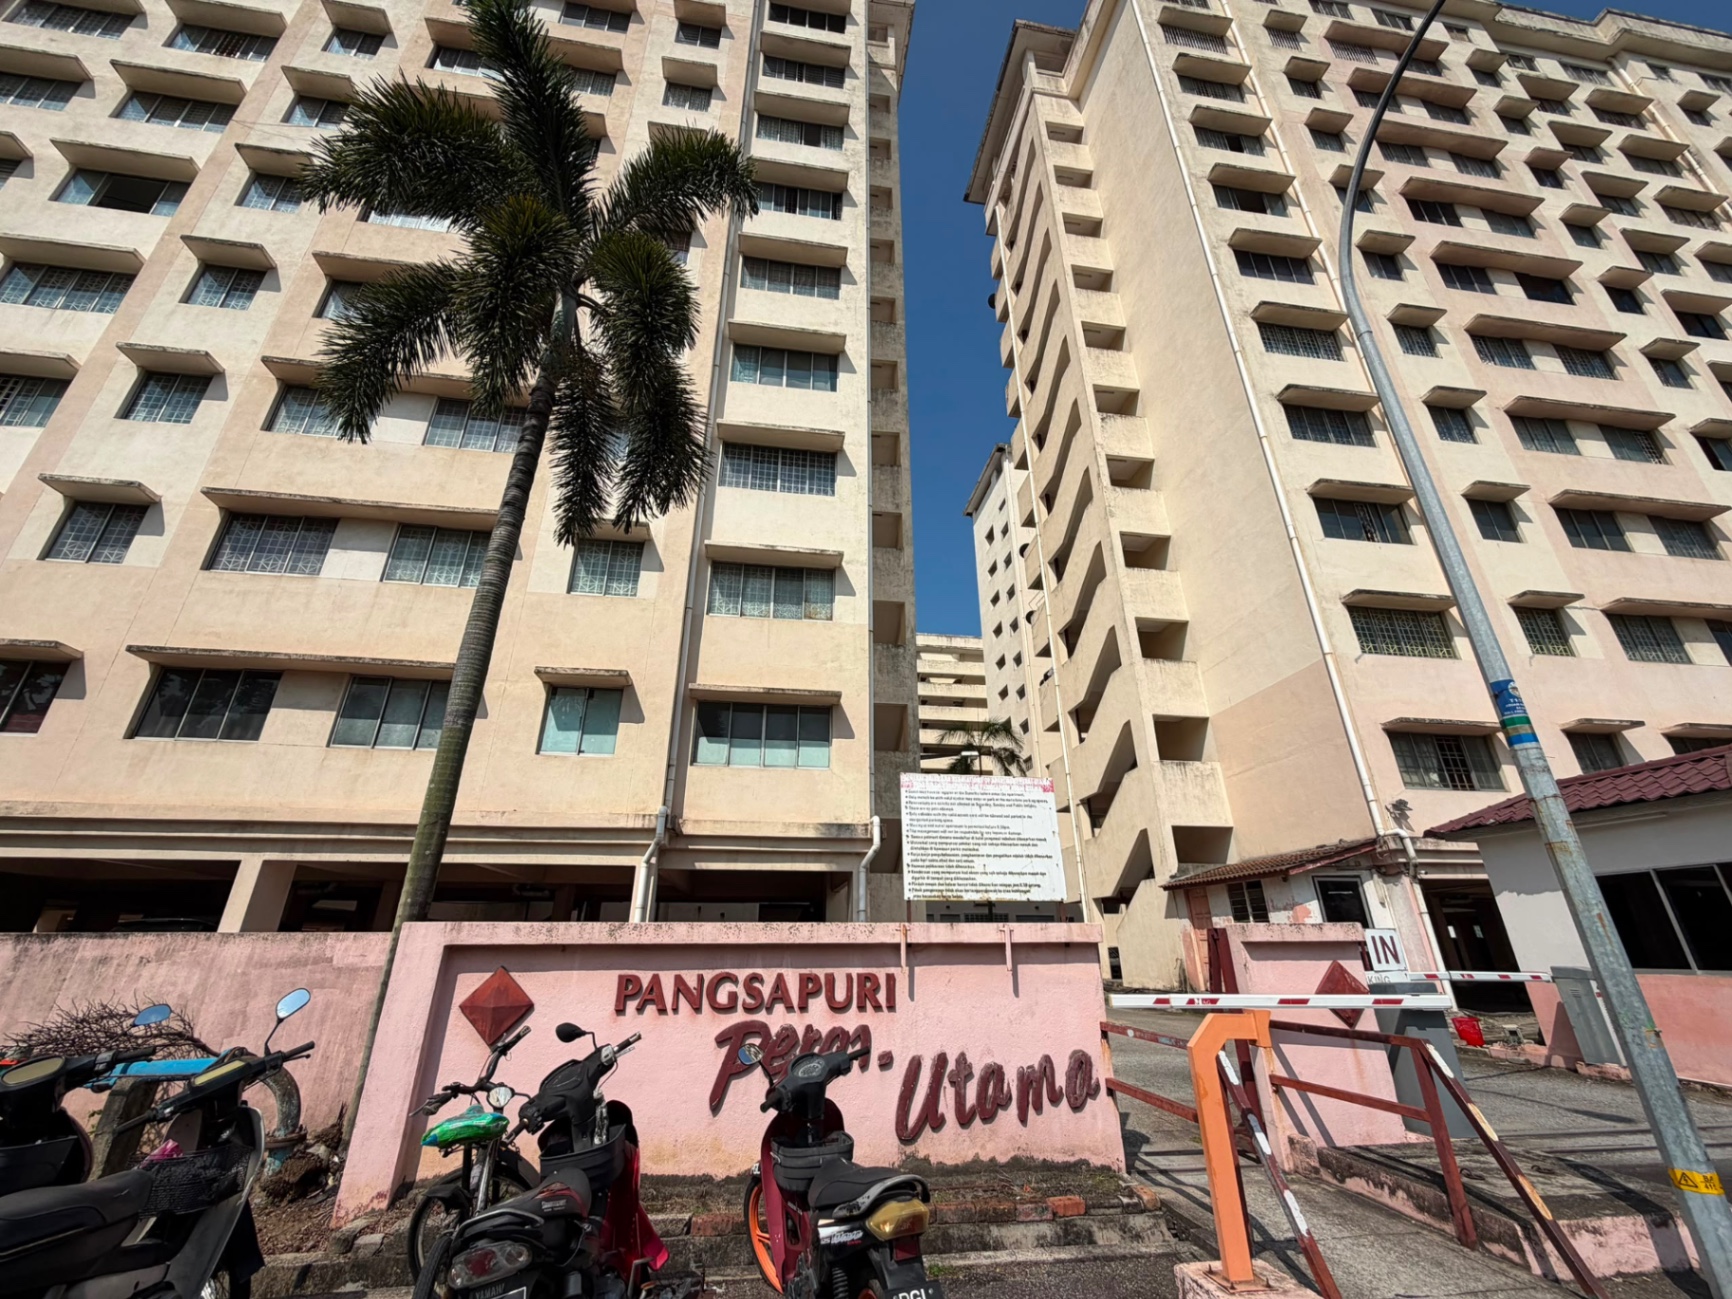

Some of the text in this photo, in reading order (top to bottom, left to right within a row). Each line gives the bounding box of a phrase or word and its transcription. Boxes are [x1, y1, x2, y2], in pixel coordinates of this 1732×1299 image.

[1371, 935, 1400, 964] IN
[614, 971, 897, 1013] PANGSAPURI
[895, 1049, 1101, 1140] Utama
